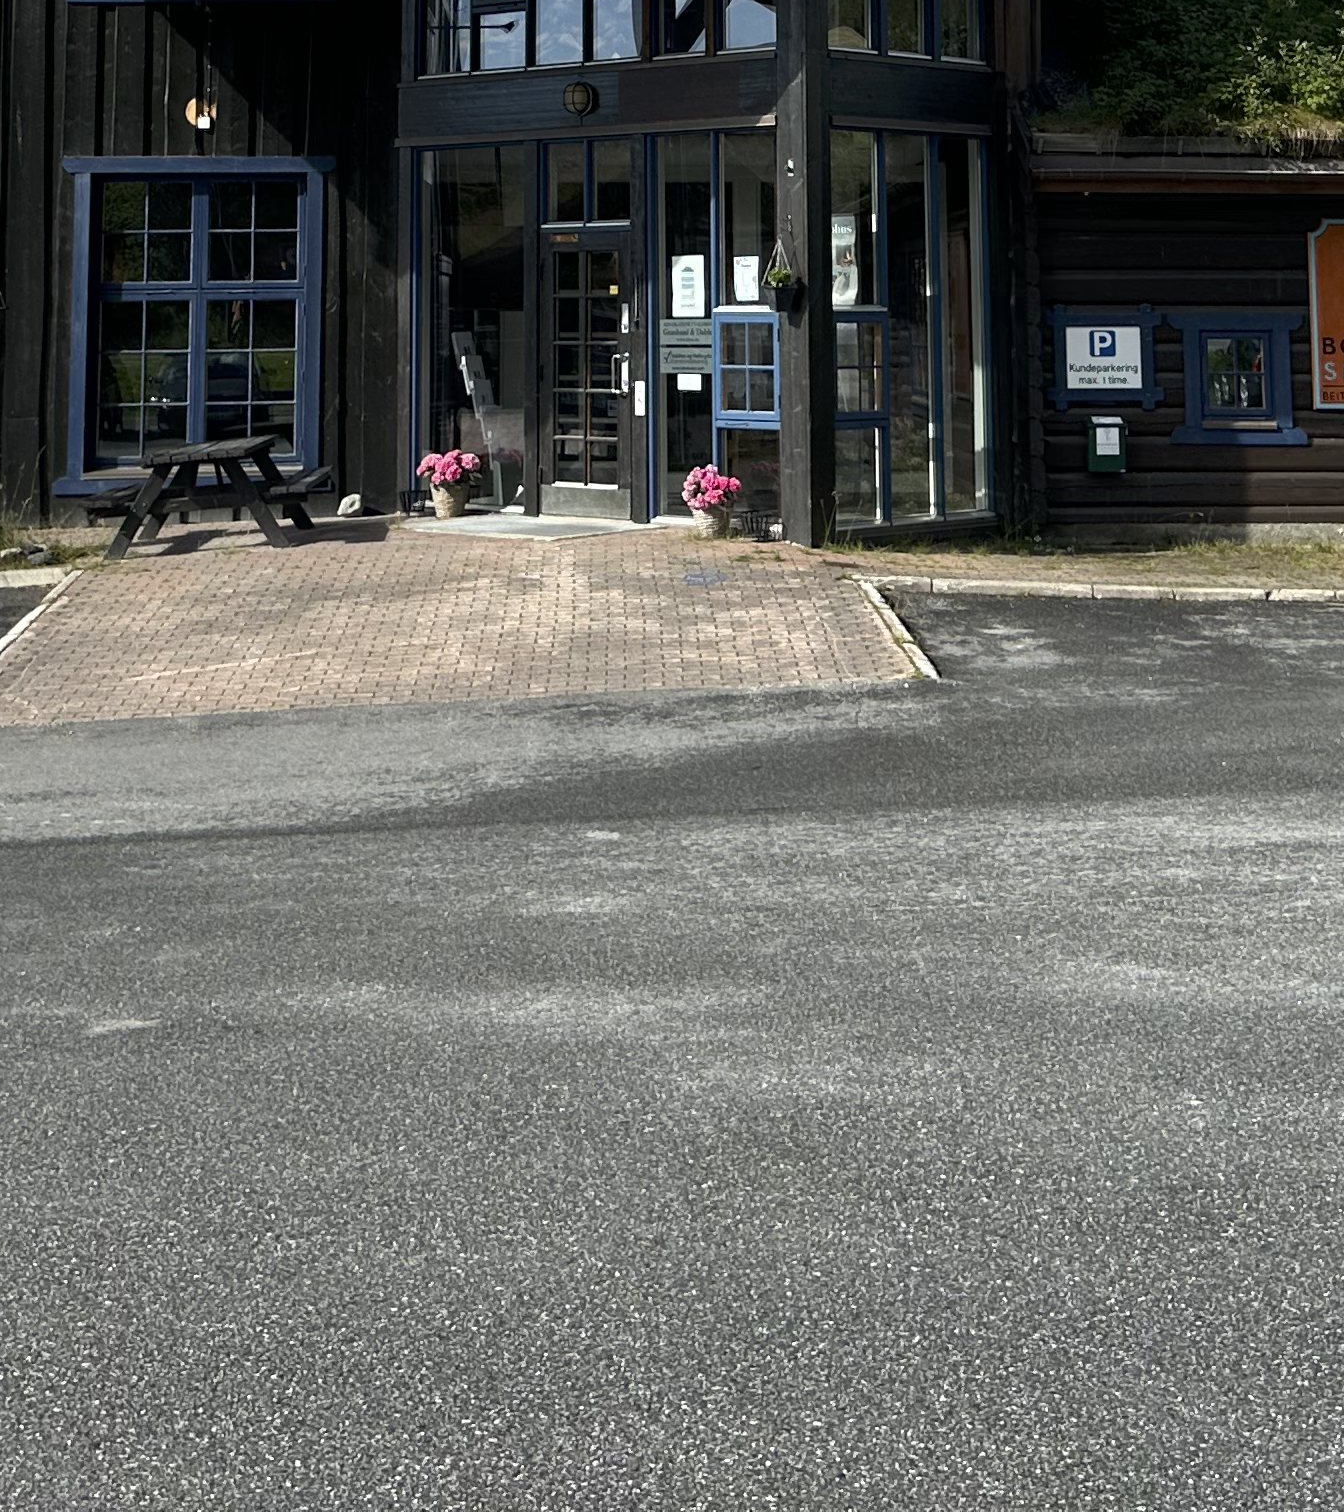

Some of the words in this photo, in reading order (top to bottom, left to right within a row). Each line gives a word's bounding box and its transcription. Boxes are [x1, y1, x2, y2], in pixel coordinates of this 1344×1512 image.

[1093, 331, 1112, 356] P
[1069, 363, 1139, 375] Kundeparkering
[1078, 376, 1100, 385] max.
[1108, 375, 1130, 385] time.
